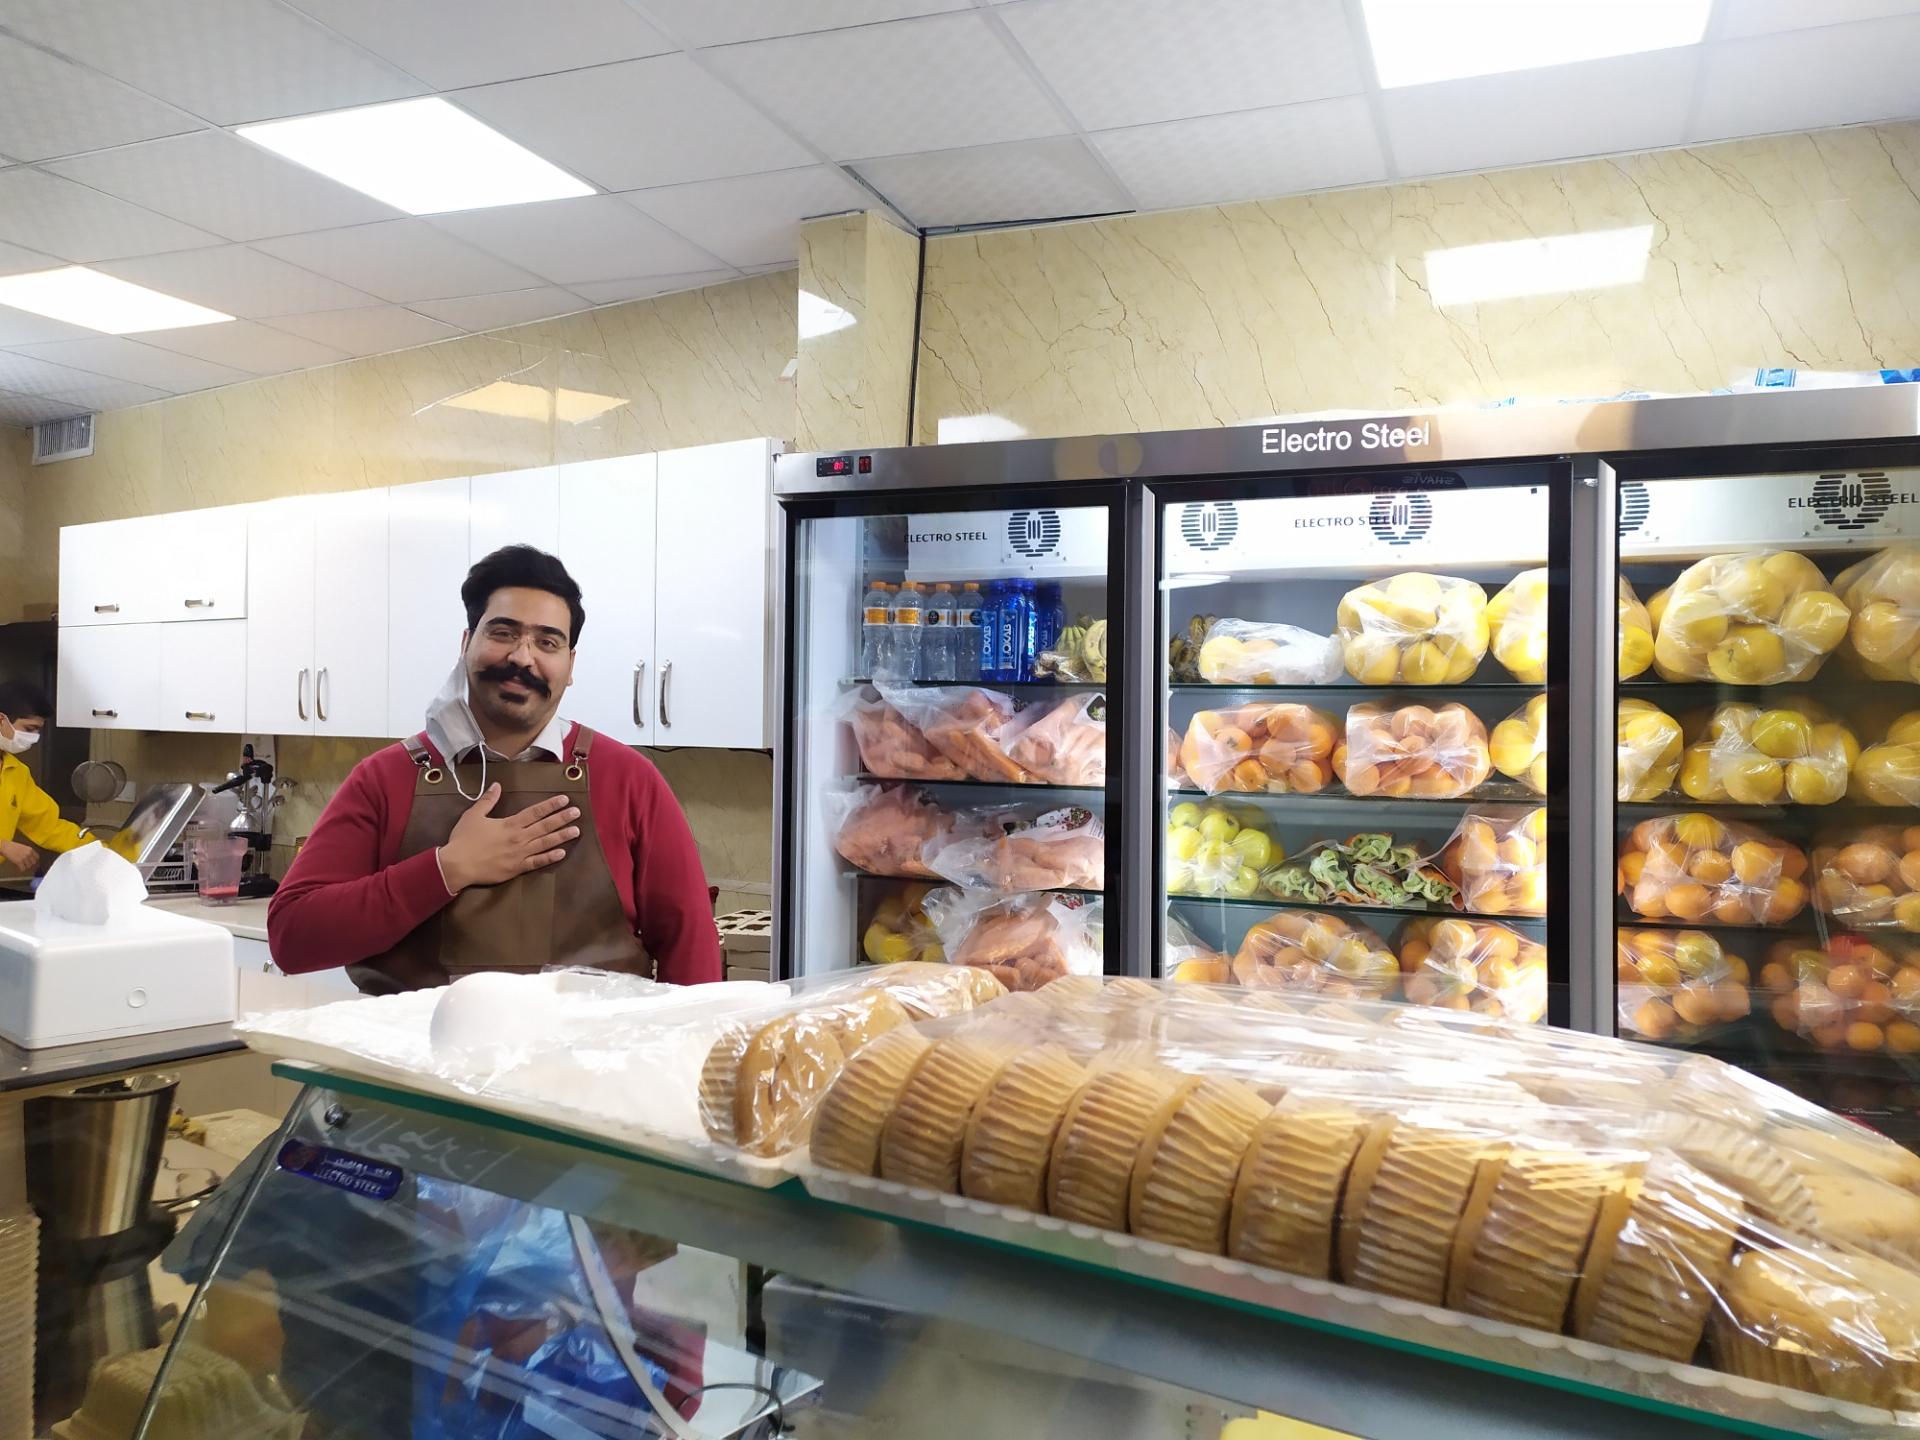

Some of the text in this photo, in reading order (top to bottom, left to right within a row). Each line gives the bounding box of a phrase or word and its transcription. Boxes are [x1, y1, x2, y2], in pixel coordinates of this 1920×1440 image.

[1262, 421, 1430, 453] Electro Steel
[1870, 492, 1920, 505] STEEL
[1294, 516, 1354, 528] ELECTRO
[903, 532, 988, 543] ELECTRO STEEL
